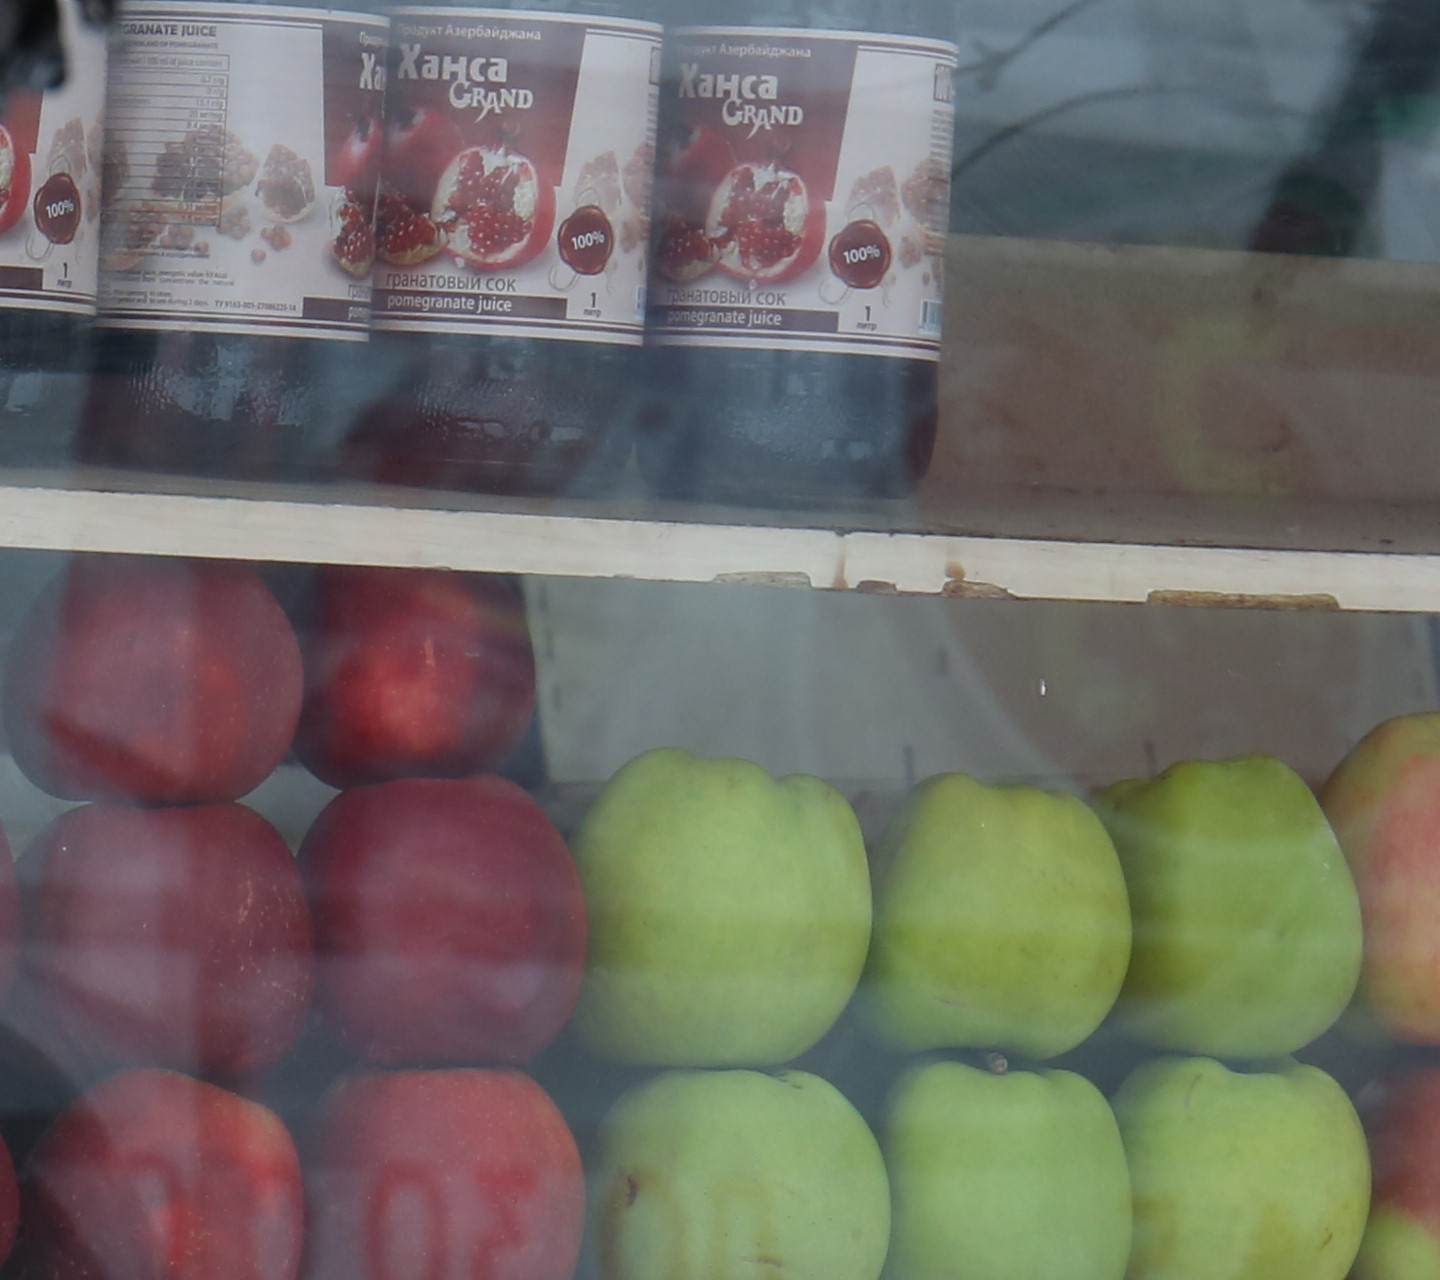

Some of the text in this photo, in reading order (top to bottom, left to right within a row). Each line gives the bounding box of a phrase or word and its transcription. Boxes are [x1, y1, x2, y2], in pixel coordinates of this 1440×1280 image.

[181, 24, 217, 38] JUICE
[444, 24, 542, 42] Азербайджана
[448, 81, 534, 124] GRAND
[721, 99, 804, 140] GRAND
[45, 200, 74, 219] 100%
[570, 231, 606, 250] 100%
[842, 245, 881, 265] 100%
[385, 271, 481, 293] гранатовый
[485, 276, 517, 293] сок
[386, 293, 476, 313] pomegranate
[476, 296, 513, 315] juice
[755, 291, 786, 307] сок
[747, 310, 783, 328] juice
